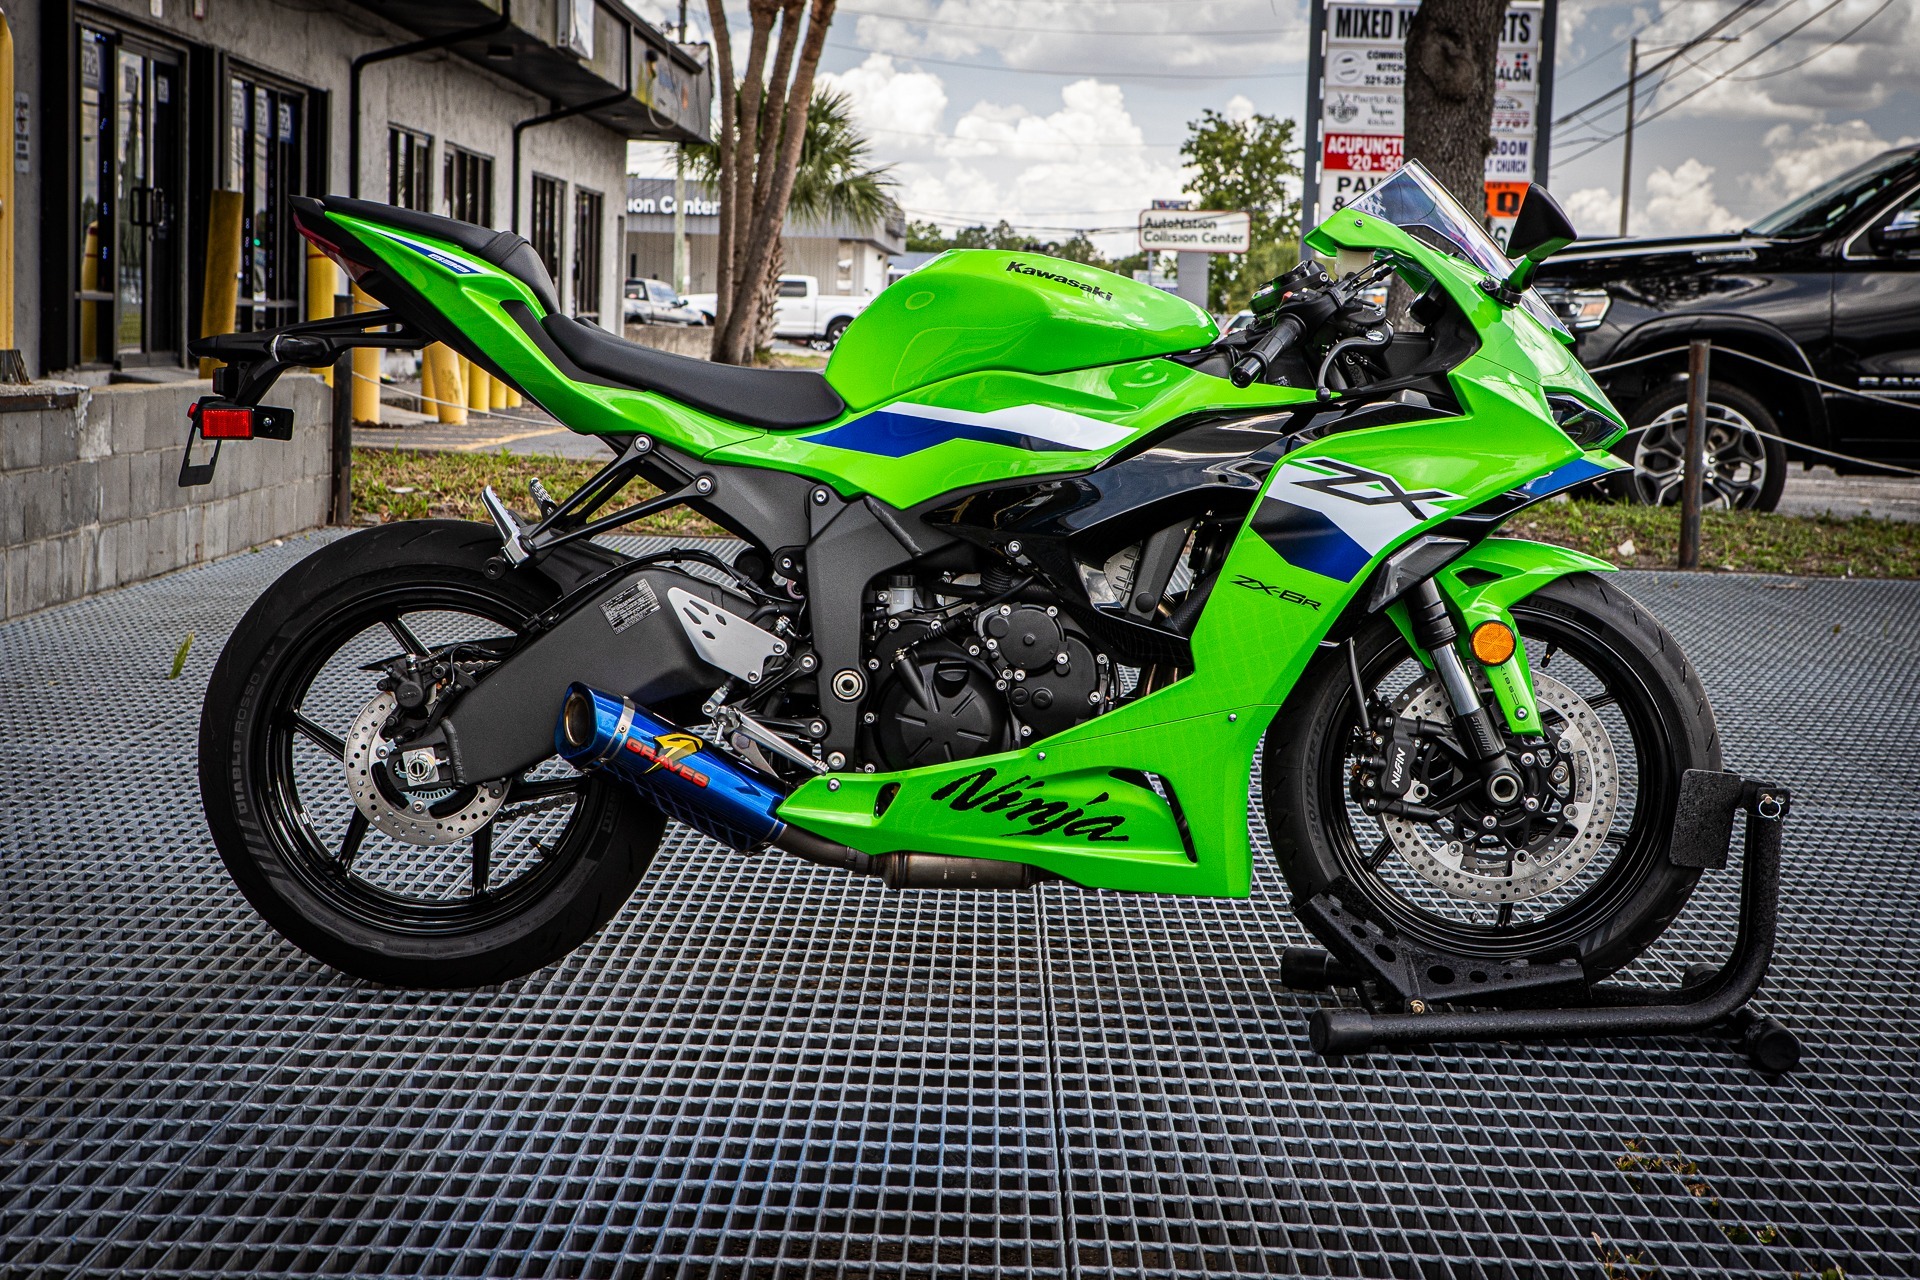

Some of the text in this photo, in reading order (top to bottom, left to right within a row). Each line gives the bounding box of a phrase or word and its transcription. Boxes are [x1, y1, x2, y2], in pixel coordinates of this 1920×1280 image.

[1335, 8, 1393, 39] MIXED
[1501, 11, 1531, 44] TS
[1496, 67, 1532, 82] ALON
[1496, 160, 1527, 173] CHURCH
[1144, 217, 1217, 229] AutoNation
[1144, 231, 1244, 244] Collision Center
[1005, 261, 1114, 301] Kawasaki
[1230, 574, 1322, 612] ZX-6R
[235, 671, 260, 732] ROSSO
[231, 739, 250, 815] DIABLO
[625, 736, 711, 790] GRAVES
[931, 767, 1130, 842] Ninja
